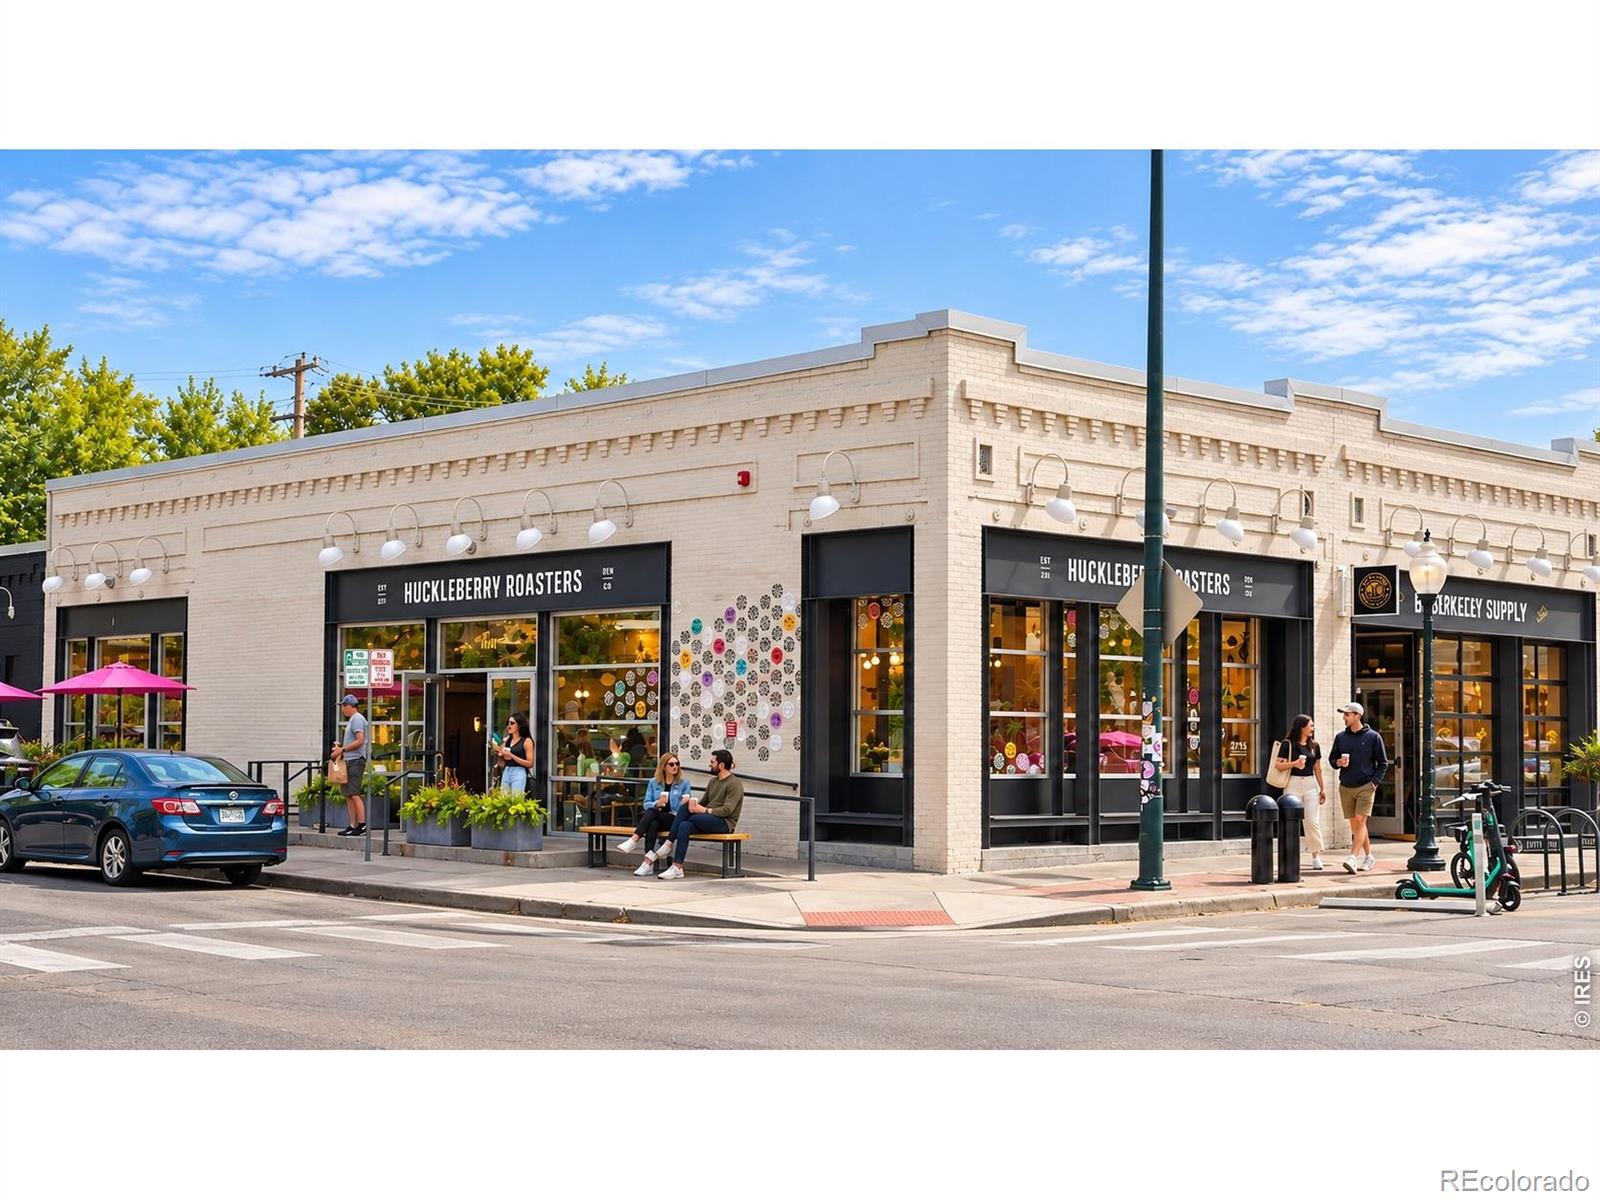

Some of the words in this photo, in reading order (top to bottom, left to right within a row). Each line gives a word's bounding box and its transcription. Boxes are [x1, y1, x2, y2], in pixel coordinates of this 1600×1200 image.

[404, 576, 501, 604] HUCKLEBERRY
[506, 569, 583, 597] ROASTERS
[1486, 599, 1528, 623] SUPPLY
